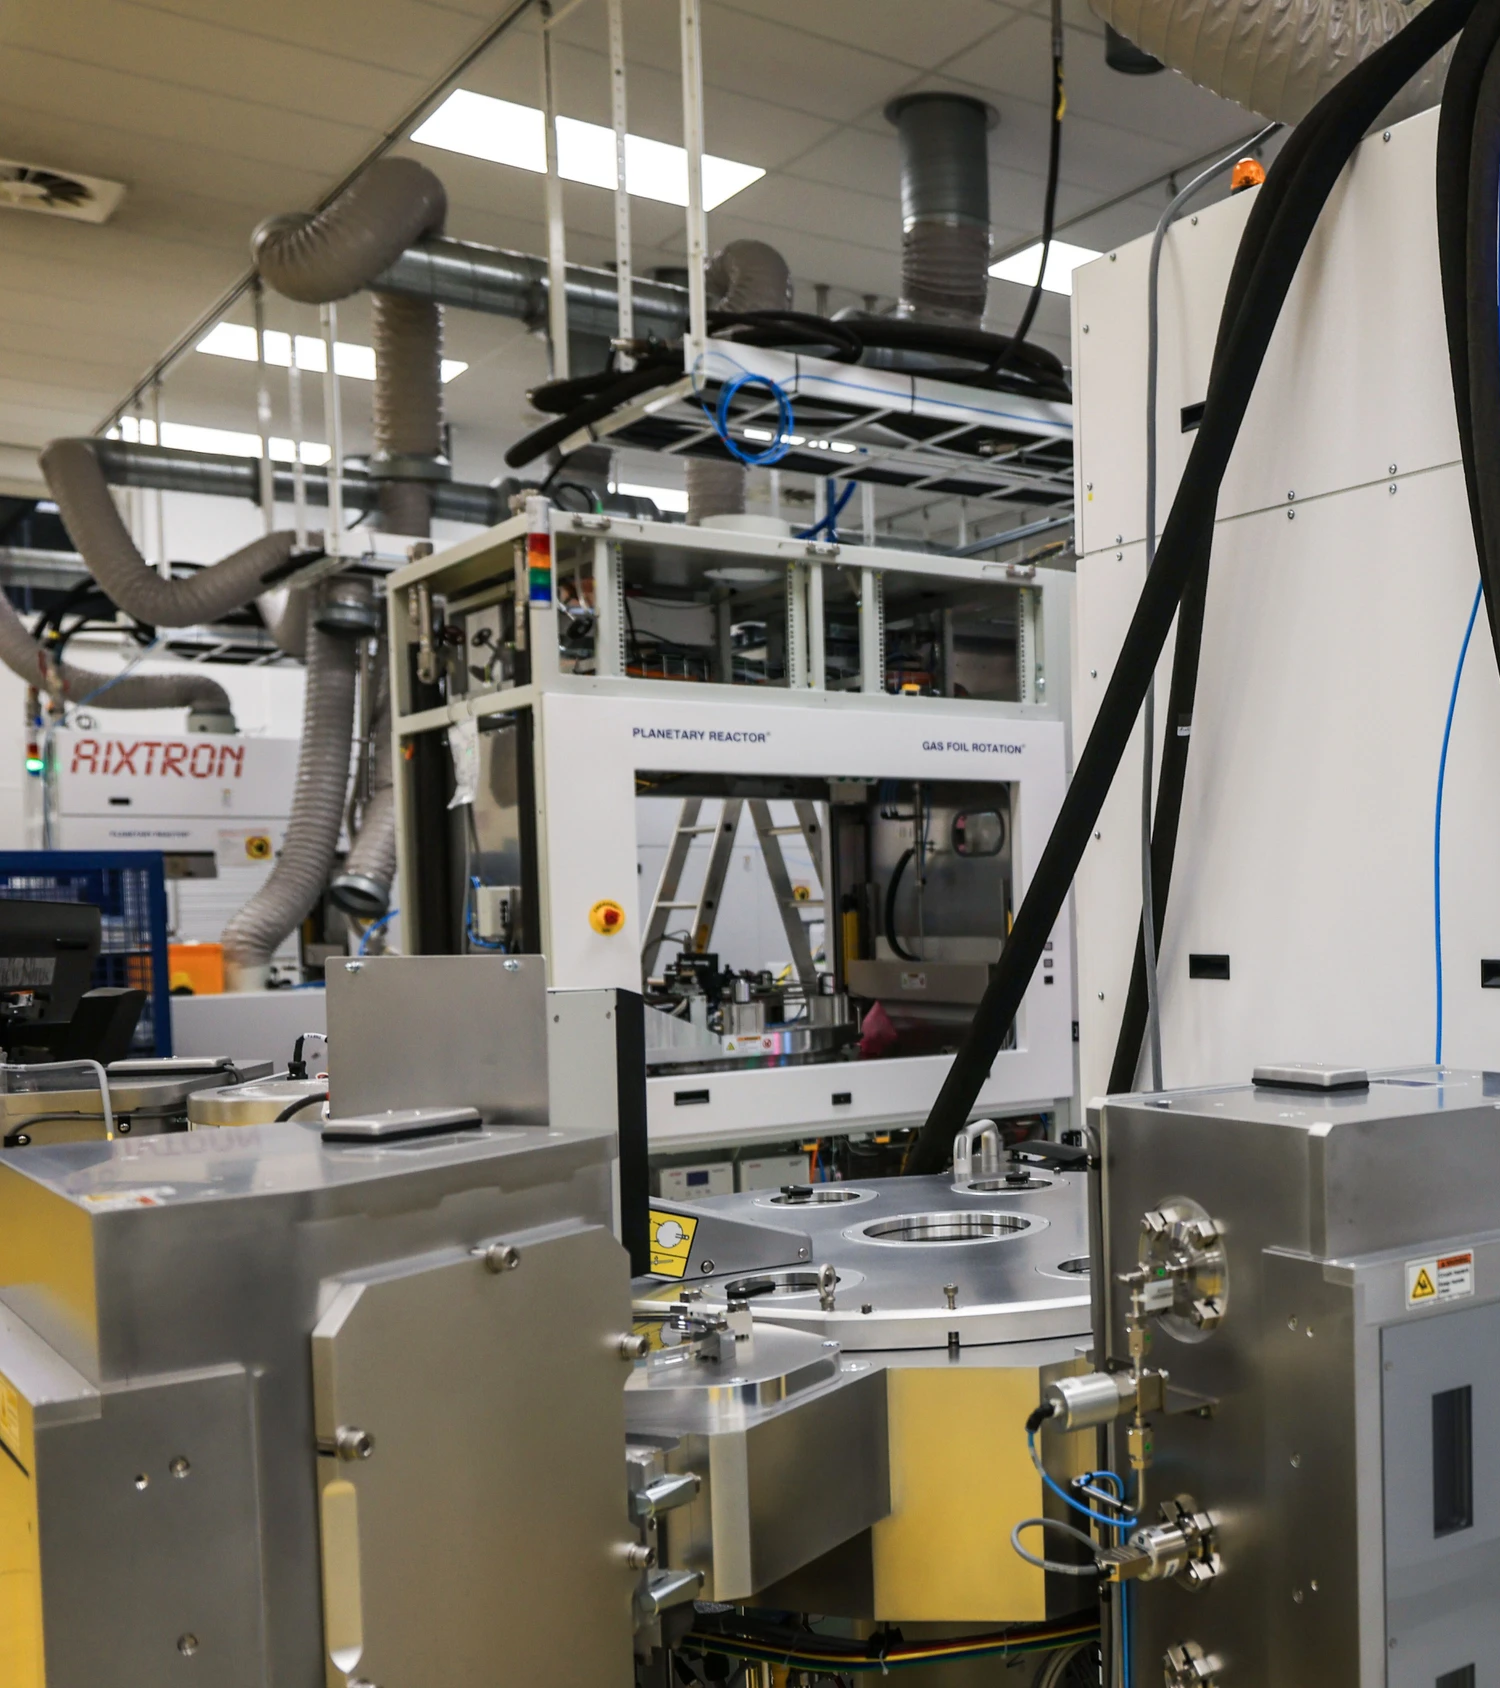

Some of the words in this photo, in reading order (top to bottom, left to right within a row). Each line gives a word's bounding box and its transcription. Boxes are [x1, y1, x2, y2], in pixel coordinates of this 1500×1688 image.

[632, 727, 705, 740] PLANETARY
[922, 741, 944, 751] GAS
[946, 741, 969, 752] FOIL
[70, 739, 246, 779] AIXTRON
